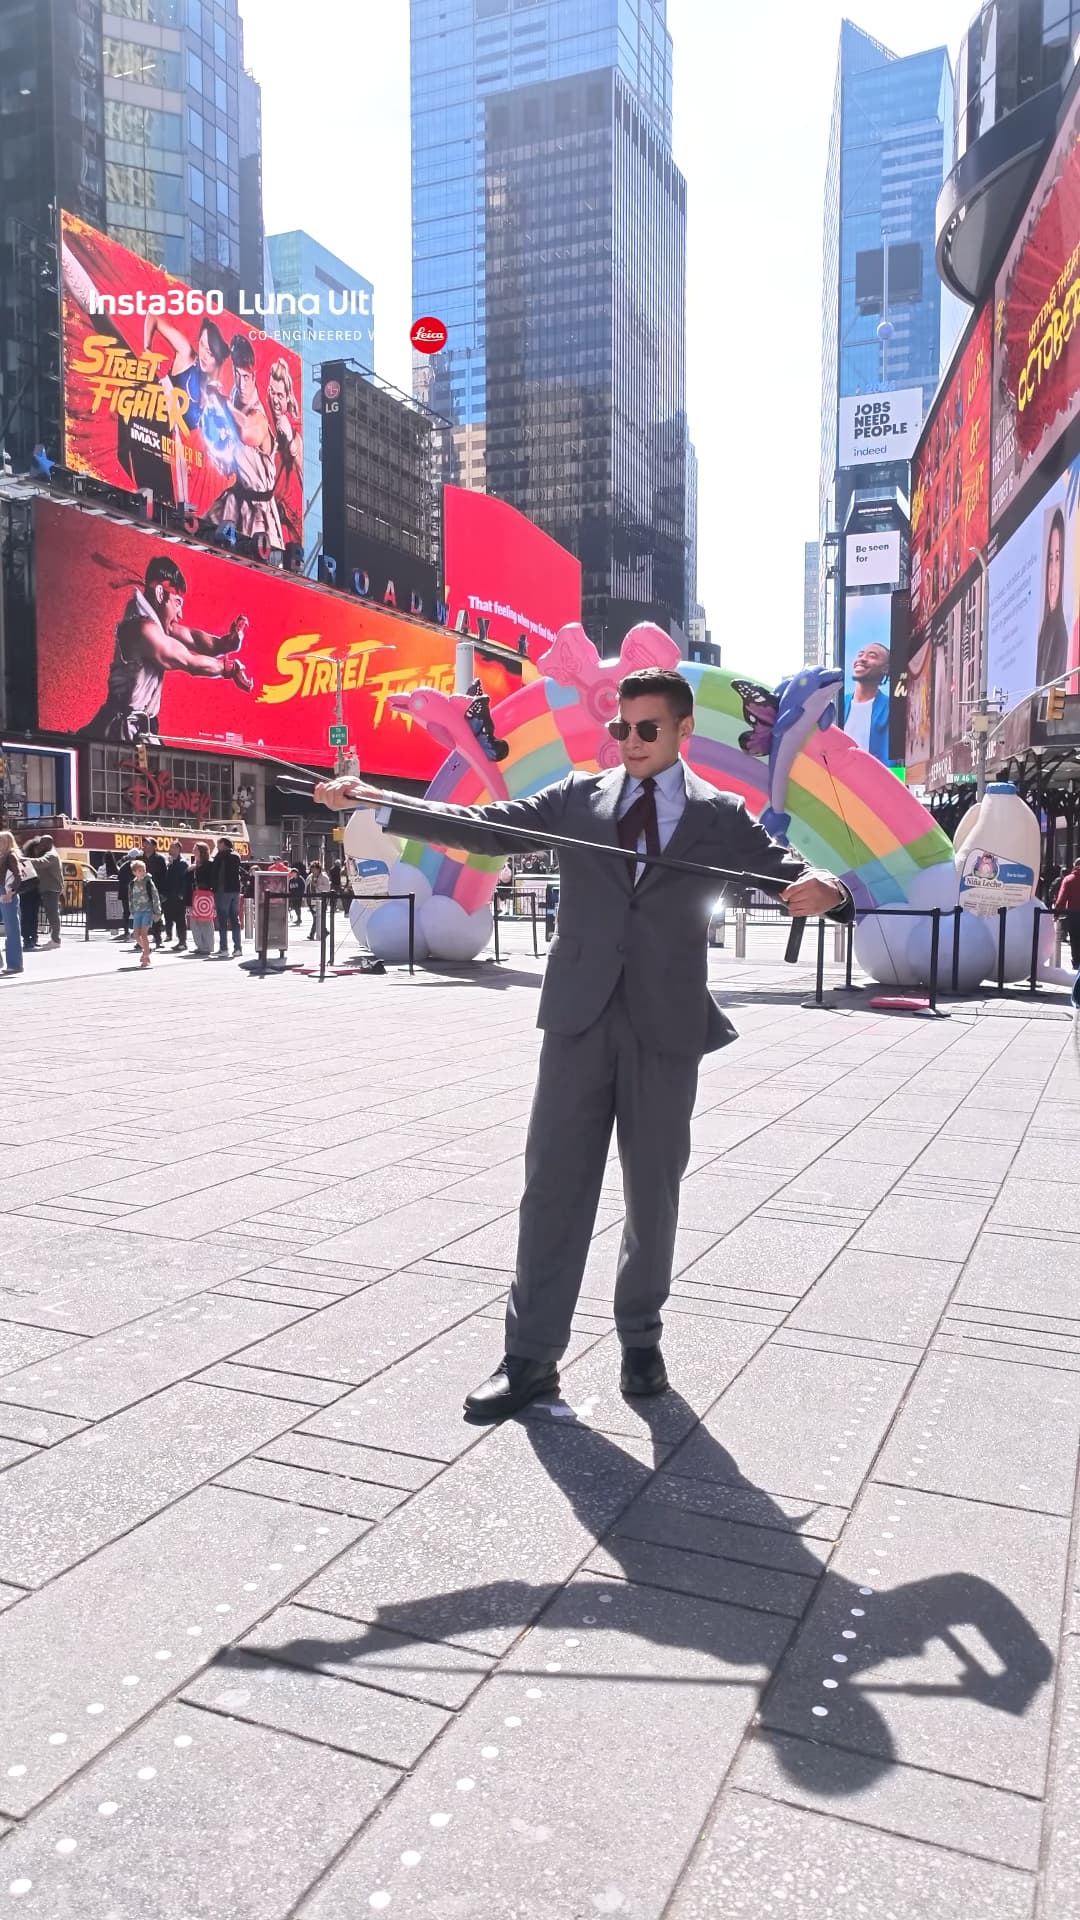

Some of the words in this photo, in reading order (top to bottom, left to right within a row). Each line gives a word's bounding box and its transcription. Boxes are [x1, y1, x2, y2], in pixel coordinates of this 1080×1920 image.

[69, 334, 169, 382] STREET
[83, 375, 192, 441] FIGHTER
[325, 401, 340, 414] LG
[854, 401, 891, 416] JOBS
[854, 414, 890, 428] NEED
[854, 422, 908, 440] PEOPLE
[130, 428, 161, 450] IMAX
[853, 444, 887, 457] indeed
[855, 545, 867, 553] Be
[868, 544, 889, 552] seen
[855, 555, 868, 563] for
[467, 595, 493, 613] That
[493, 601, 518, 625] feeling
[255, 633, 385, 704] STREET
[953, 775, 960, 783] W
[962, 774, 970, 782] 46
